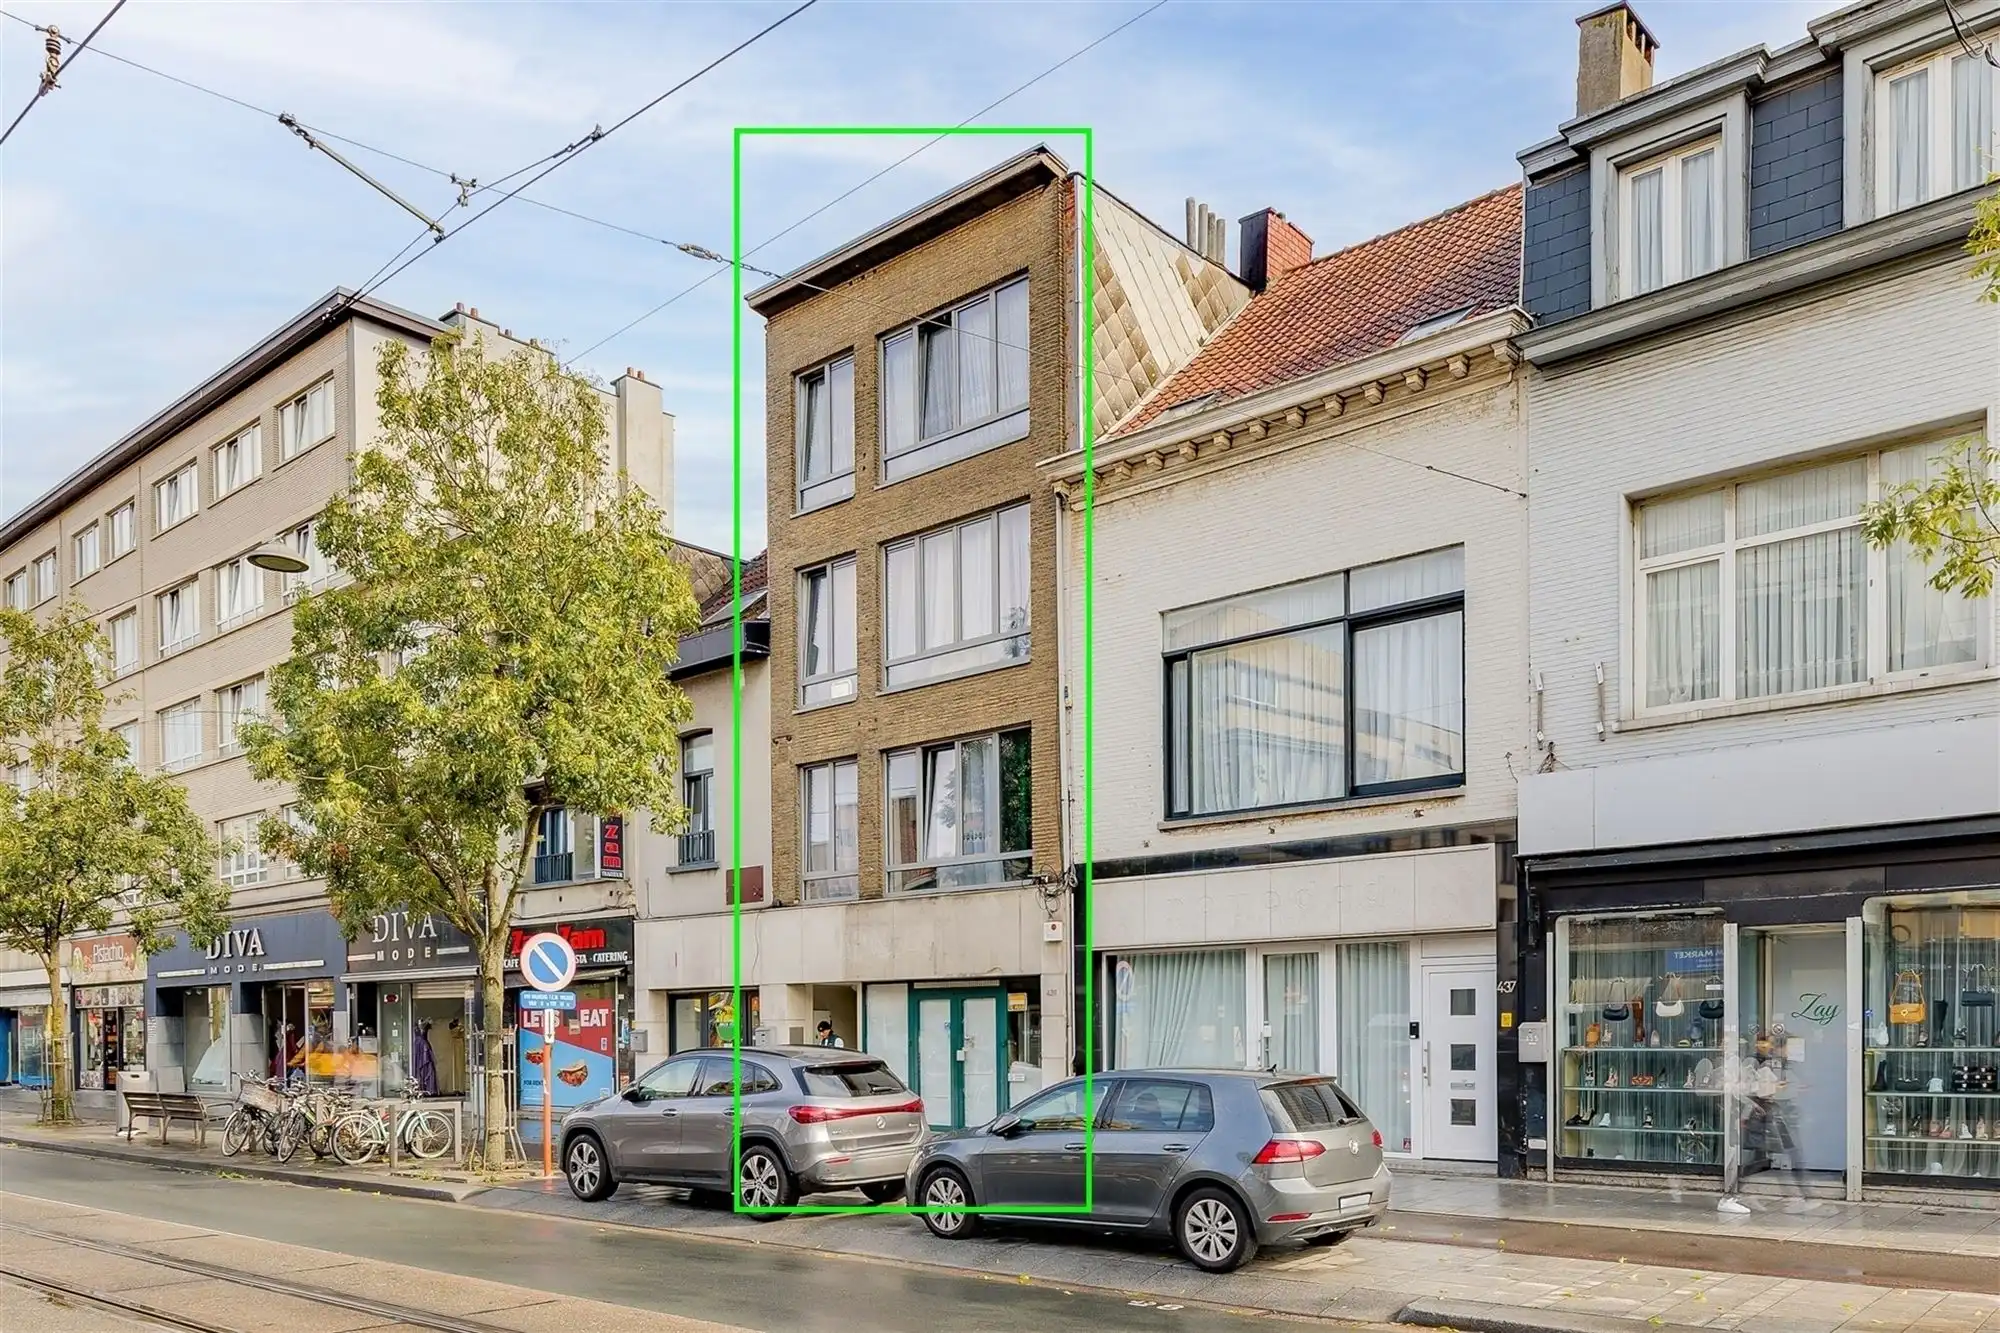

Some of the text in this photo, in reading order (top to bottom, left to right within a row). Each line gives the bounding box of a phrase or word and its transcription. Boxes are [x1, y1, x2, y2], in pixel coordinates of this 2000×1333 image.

[372, 911, 437, 943] DIVA
[205, 927, 265, 960] DIVA
[376, 946, 431, 962] MODE
[592, 951, 628, 963] CATERING
[210, 963, 258, 975] MODE
[1496, 980, 1517, 993] 437
[580, 1008, 609, 1027] EAT
